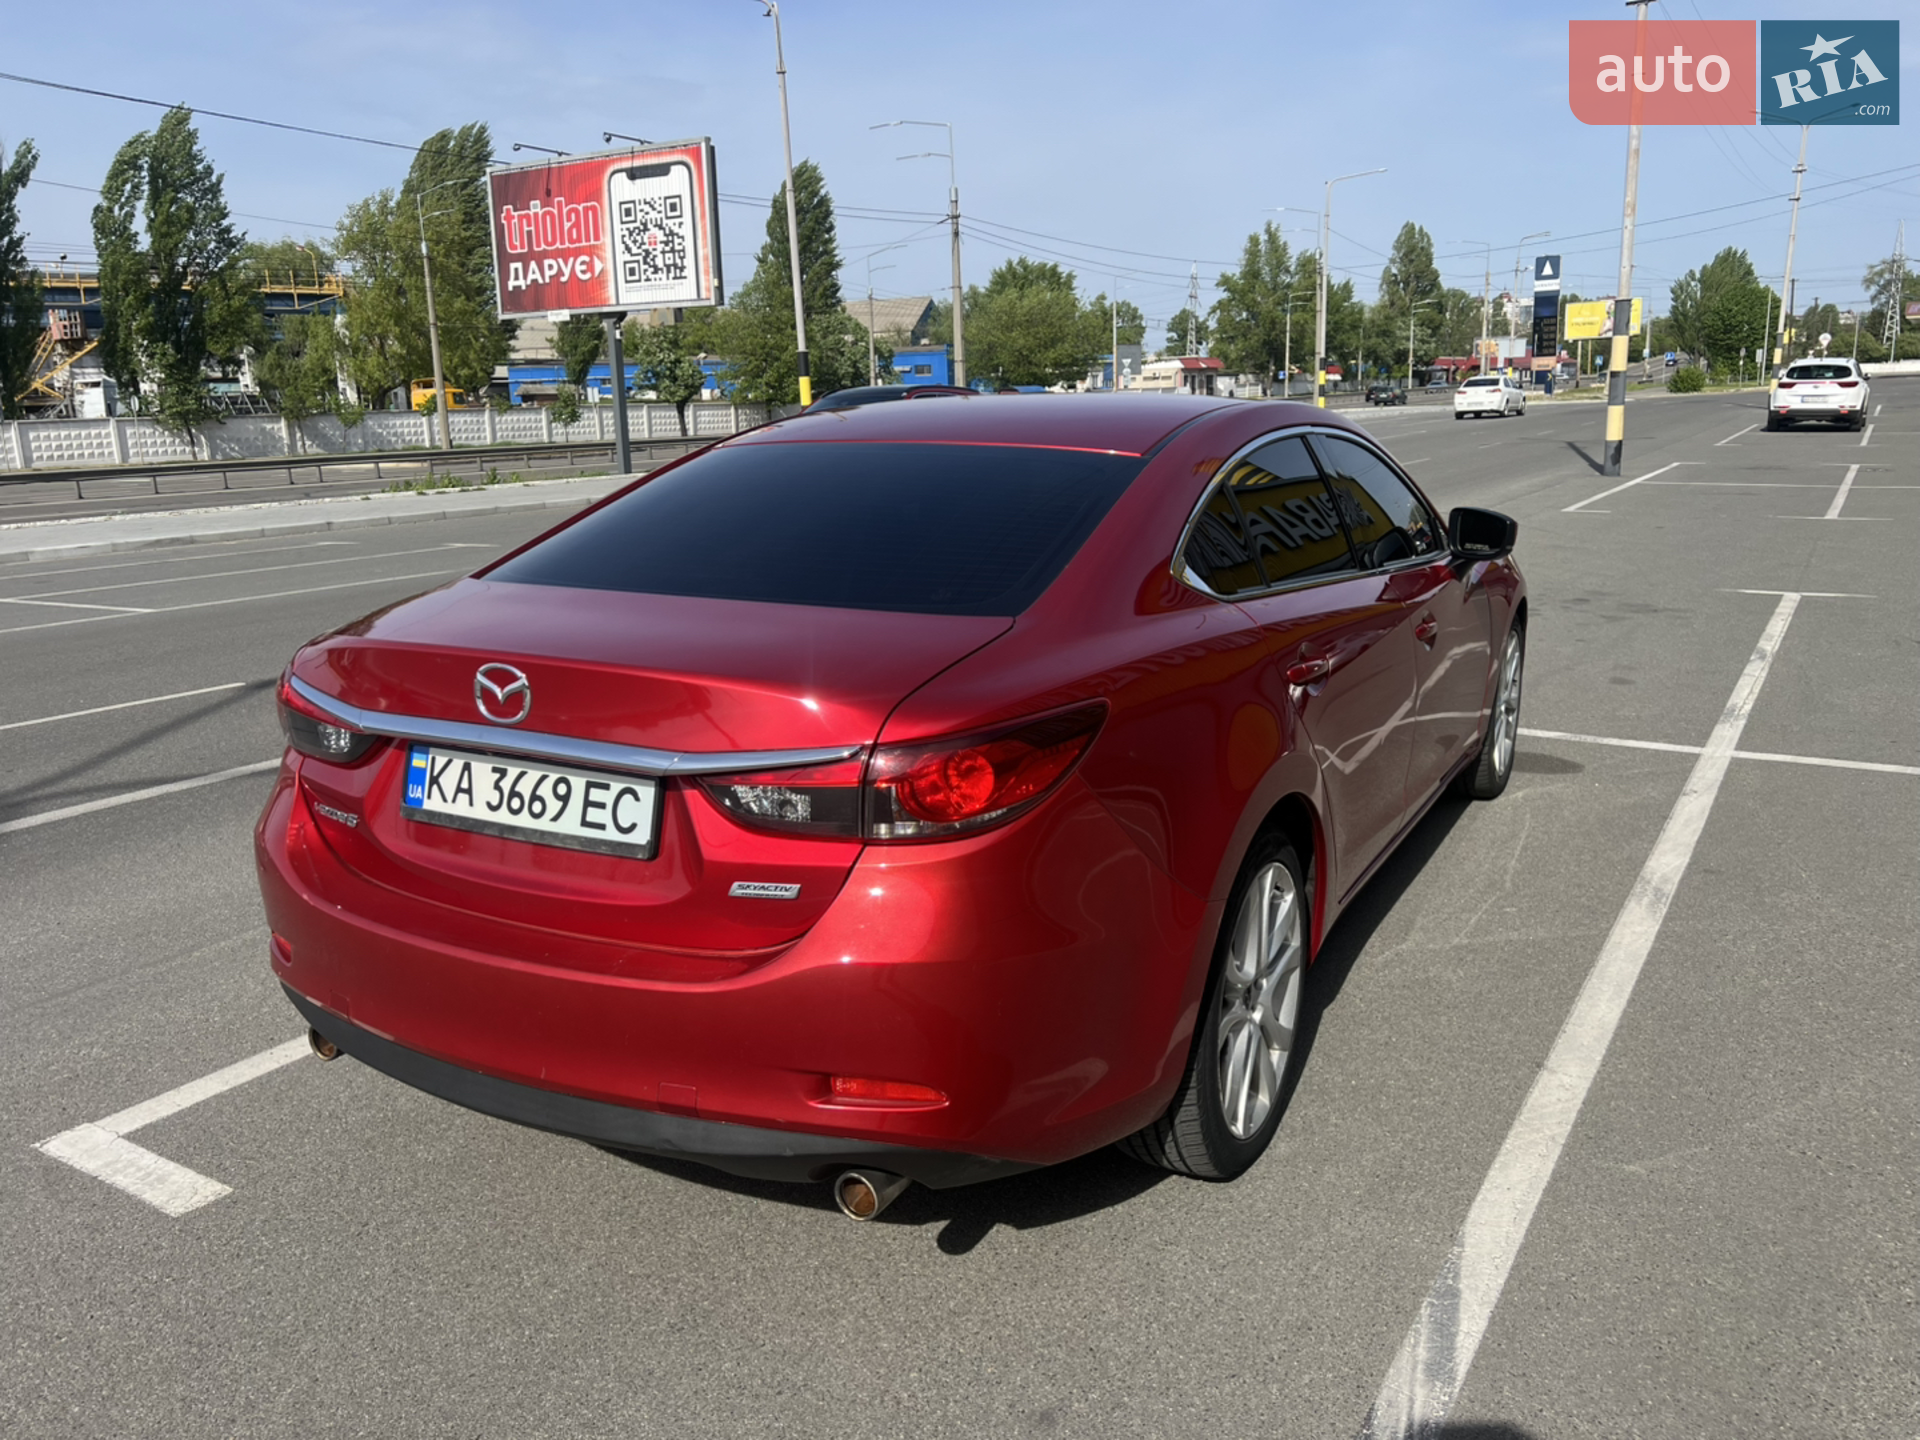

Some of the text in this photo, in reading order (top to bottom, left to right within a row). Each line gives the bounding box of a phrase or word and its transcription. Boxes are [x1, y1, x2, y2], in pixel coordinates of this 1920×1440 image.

[501, 197, 603, 254] triolan
[507, 254, 593, 291] ДАРУЄ
[408, 783, 423, 799] UA
[427, 755, 641, 835] KA 3669 EC
[736, 883, 794, 892] SKYACTIV
